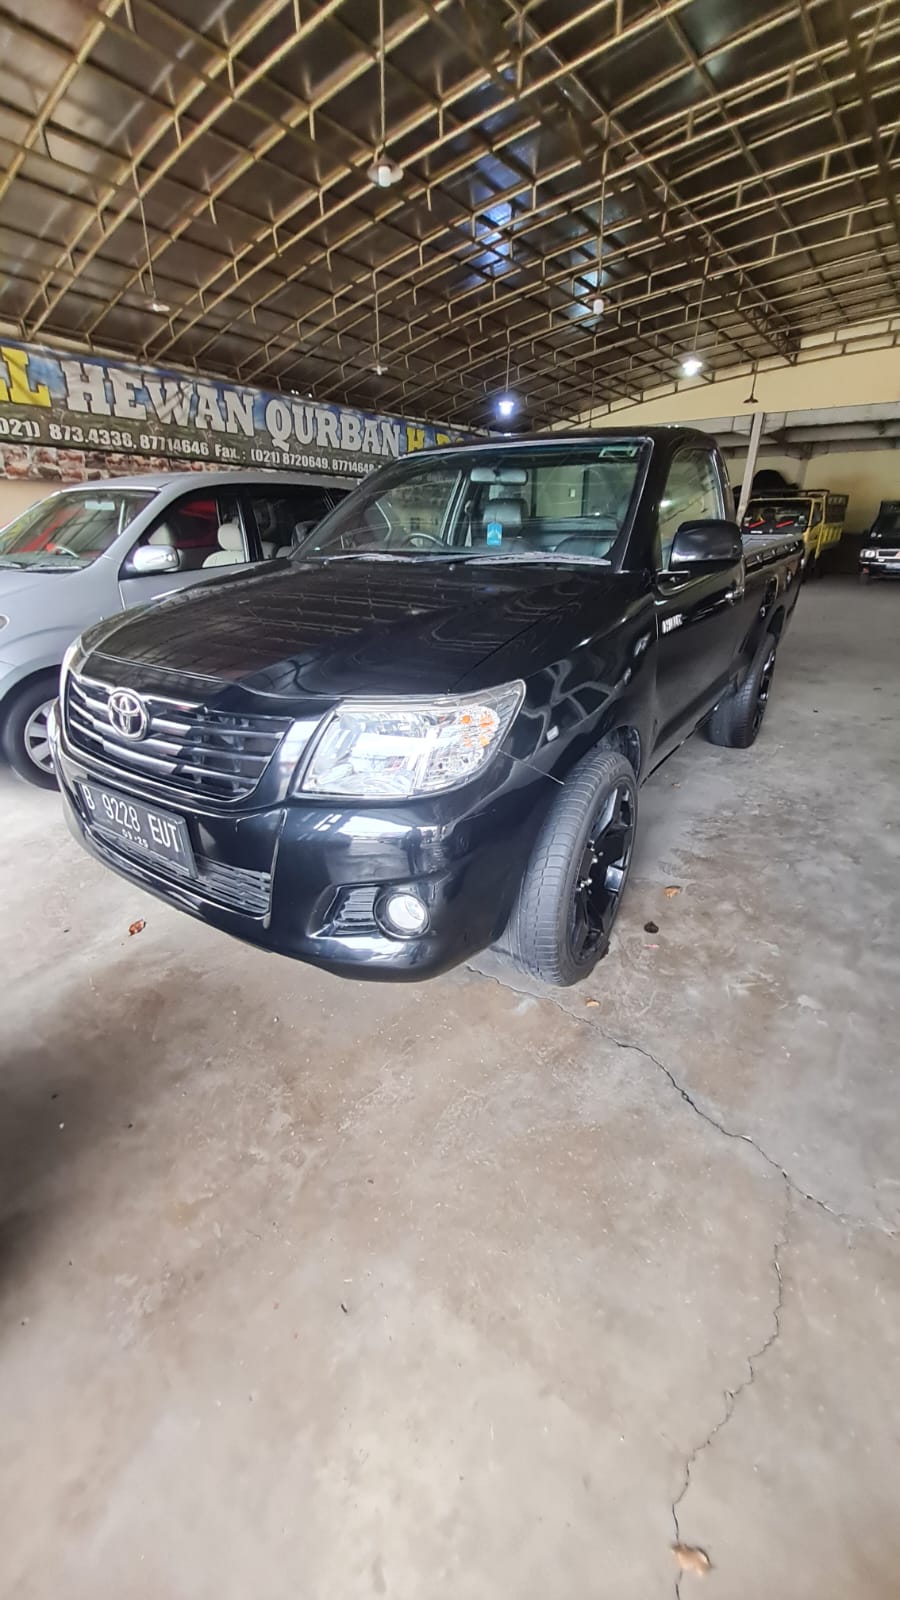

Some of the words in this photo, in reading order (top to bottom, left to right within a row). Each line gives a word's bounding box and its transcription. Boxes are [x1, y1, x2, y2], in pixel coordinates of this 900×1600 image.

[60, 360, 255, 438] HEWAN
[265, 399, 401, 458] QURBAN
[139, 434, 210, 456] 87714646
[250, 448, 280, 464] (021)
[81, 784, 96, 811] B
[101, 793, 141, 833] 9228
[147, 813, 180, 853] EUT
